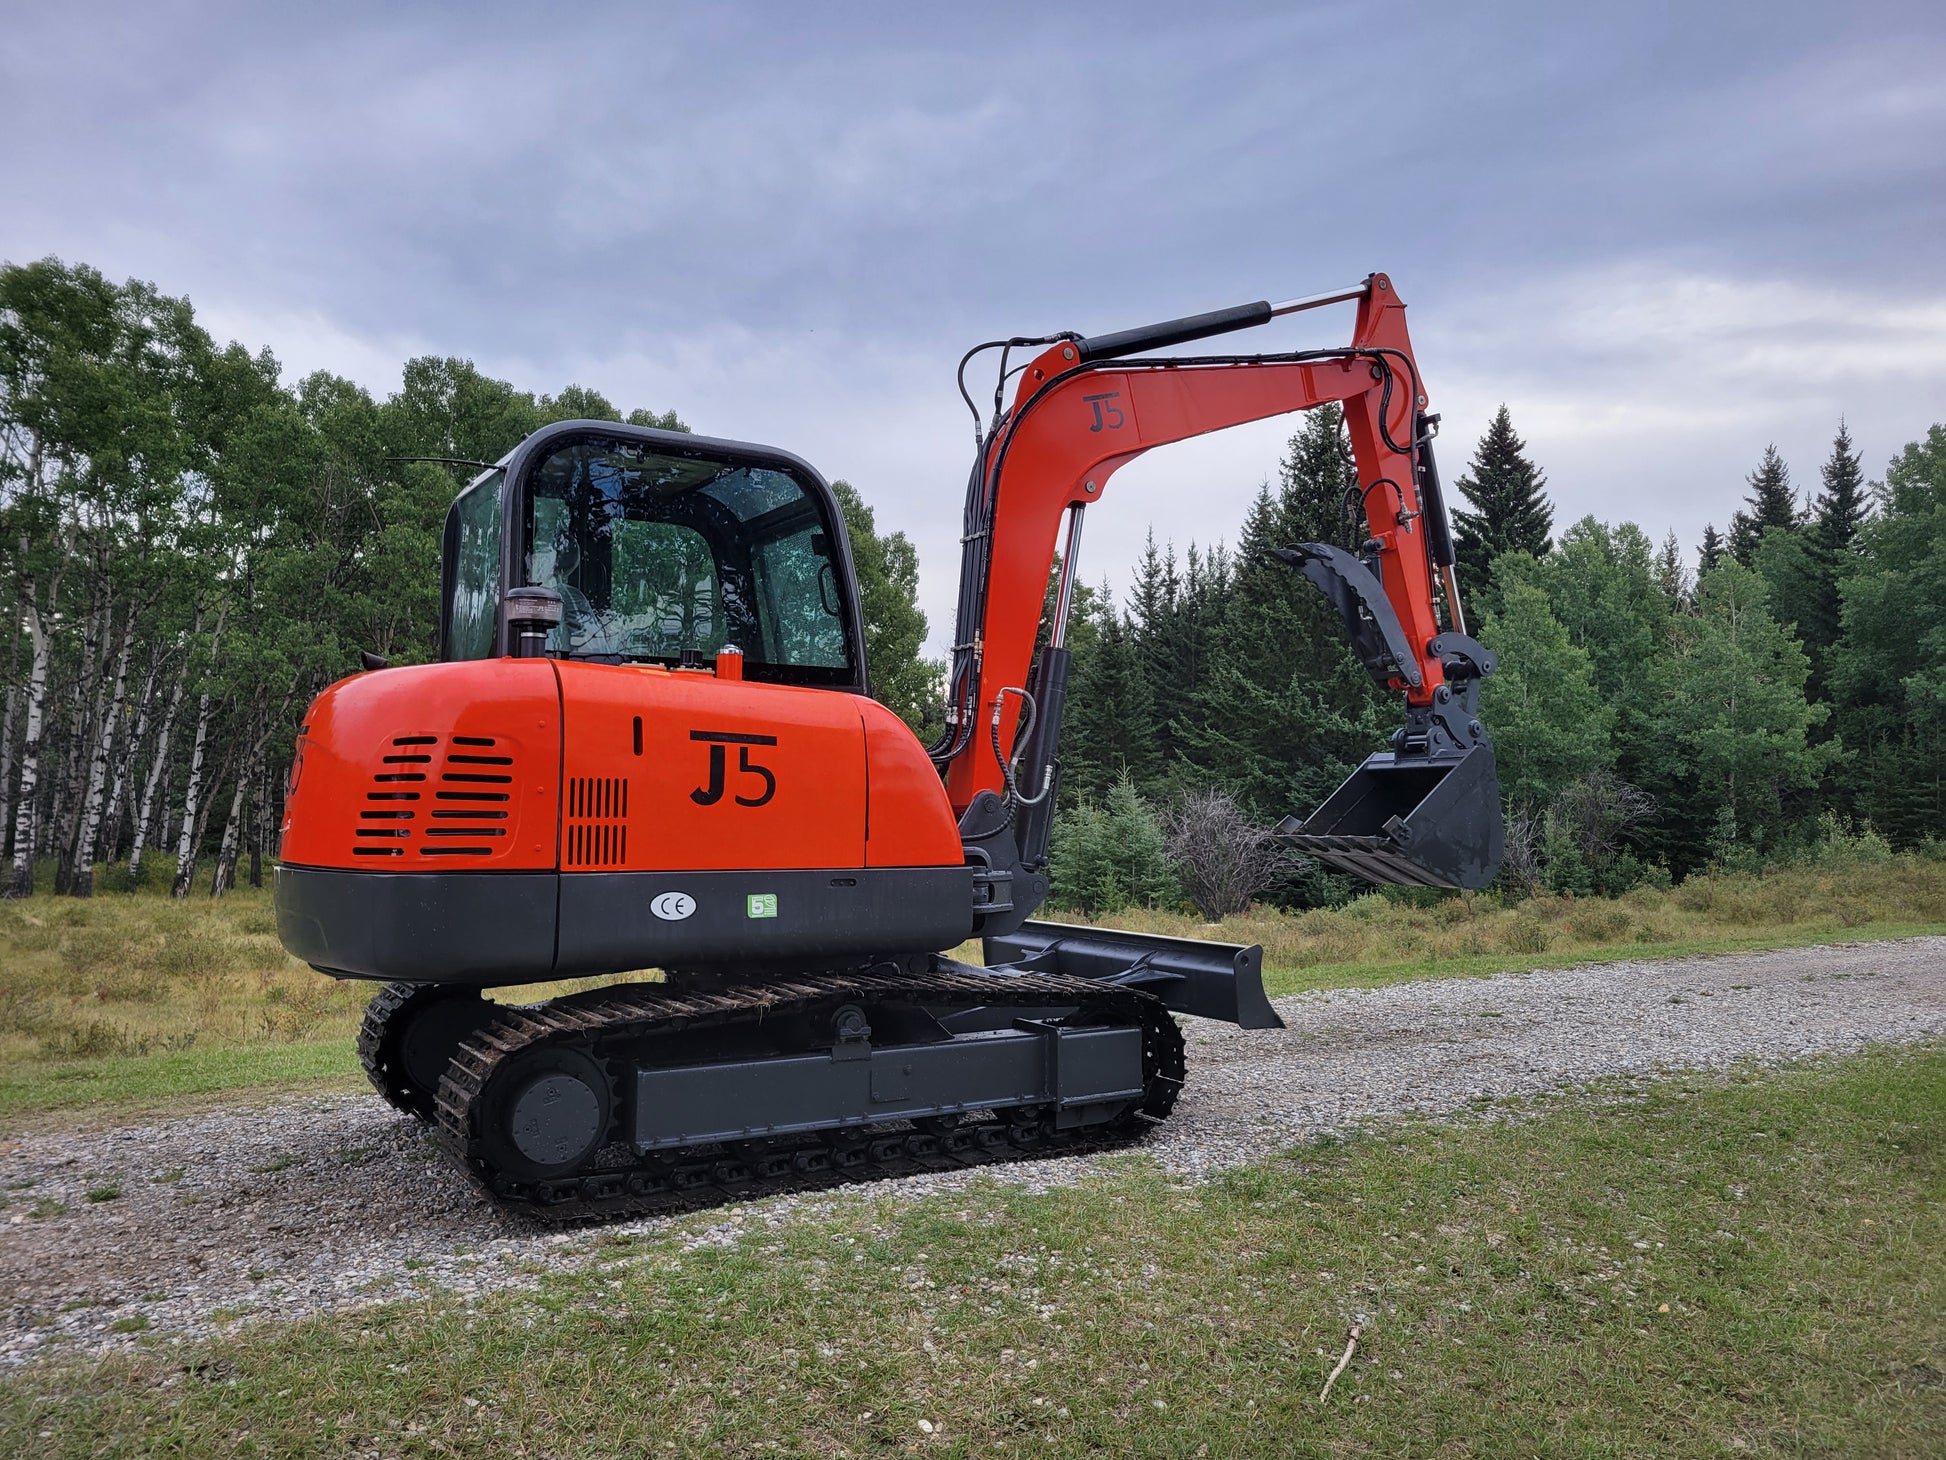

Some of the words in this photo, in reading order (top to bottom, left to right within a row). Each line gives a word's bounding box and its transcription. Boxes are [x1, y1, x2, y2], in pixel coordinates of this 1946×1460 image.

[1082, 391, 1124, 432] J5
[690, 730, 777, 807] J5
[661, 897, 685, 915] CE
